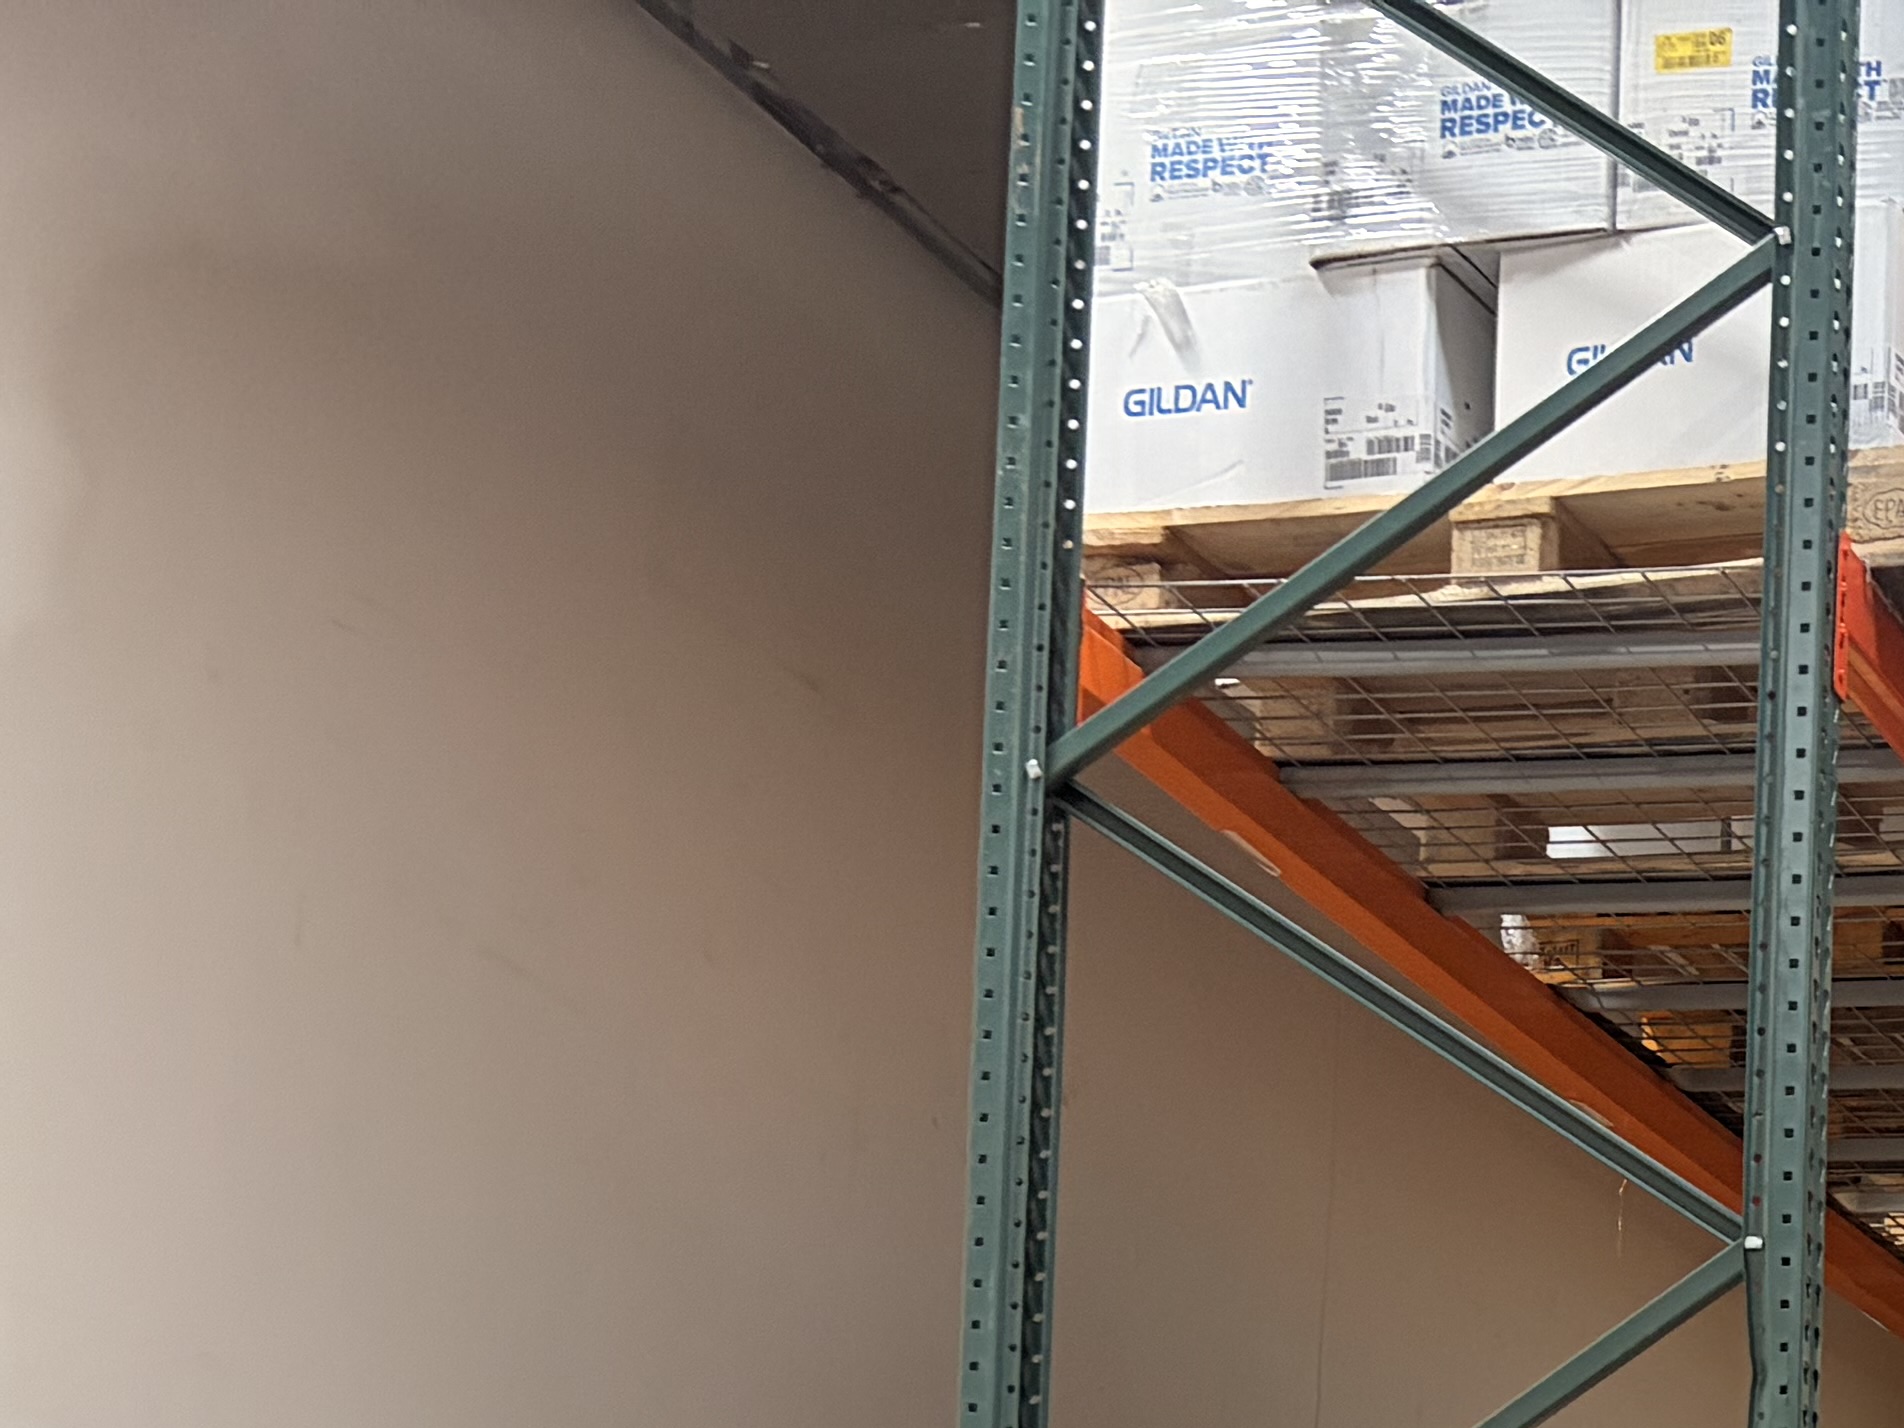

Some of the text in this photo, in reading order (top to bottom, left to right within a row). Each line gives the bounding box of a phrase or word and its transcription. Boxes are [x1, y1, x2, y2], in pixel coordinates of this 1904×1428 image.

[1440, 94, 1504, 116] MADE
[1440, 111, 1551, 139] RESPEC
[1123, 379, 1253, 417] GILDAN
